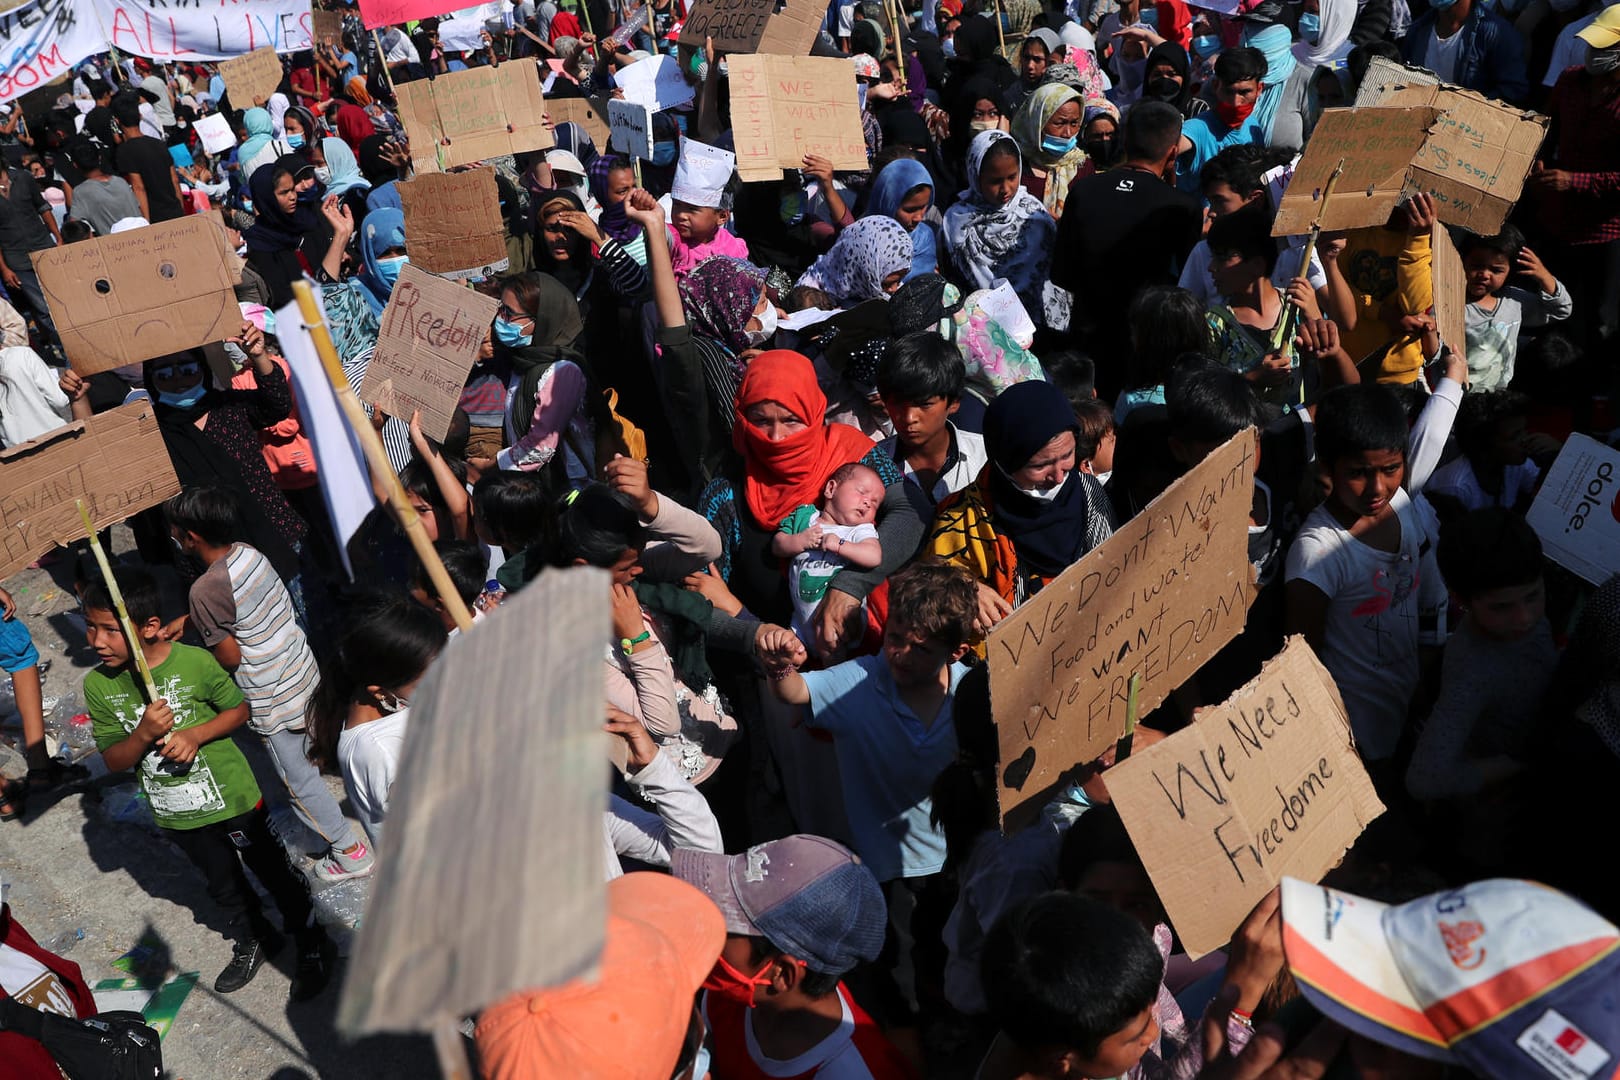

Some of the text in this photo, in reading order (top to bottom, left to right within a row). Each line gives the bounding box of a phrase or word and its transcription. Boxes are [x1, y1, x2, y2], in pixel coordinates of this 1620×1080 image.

[112, 7, 314, 56] ALL LIVES
[704, 12, 765, 41] GREECE
[741, 64, 768, 157] Finland
[786, 95, 844, 121] want
[793, 127, 865, 157] Freedom
[14, 463, 89, 514] WANT
[1001, 442, 1253, 666] We Dont Want
[1050, 519, 1218, 684] Food and water
[1086, 580, 1247, 743] FREEDOM
[1022, 680, 1080, 742] We
[1151, 679, 1301, 821] We Need
[1212, 755, 1335, 885] Freedome
